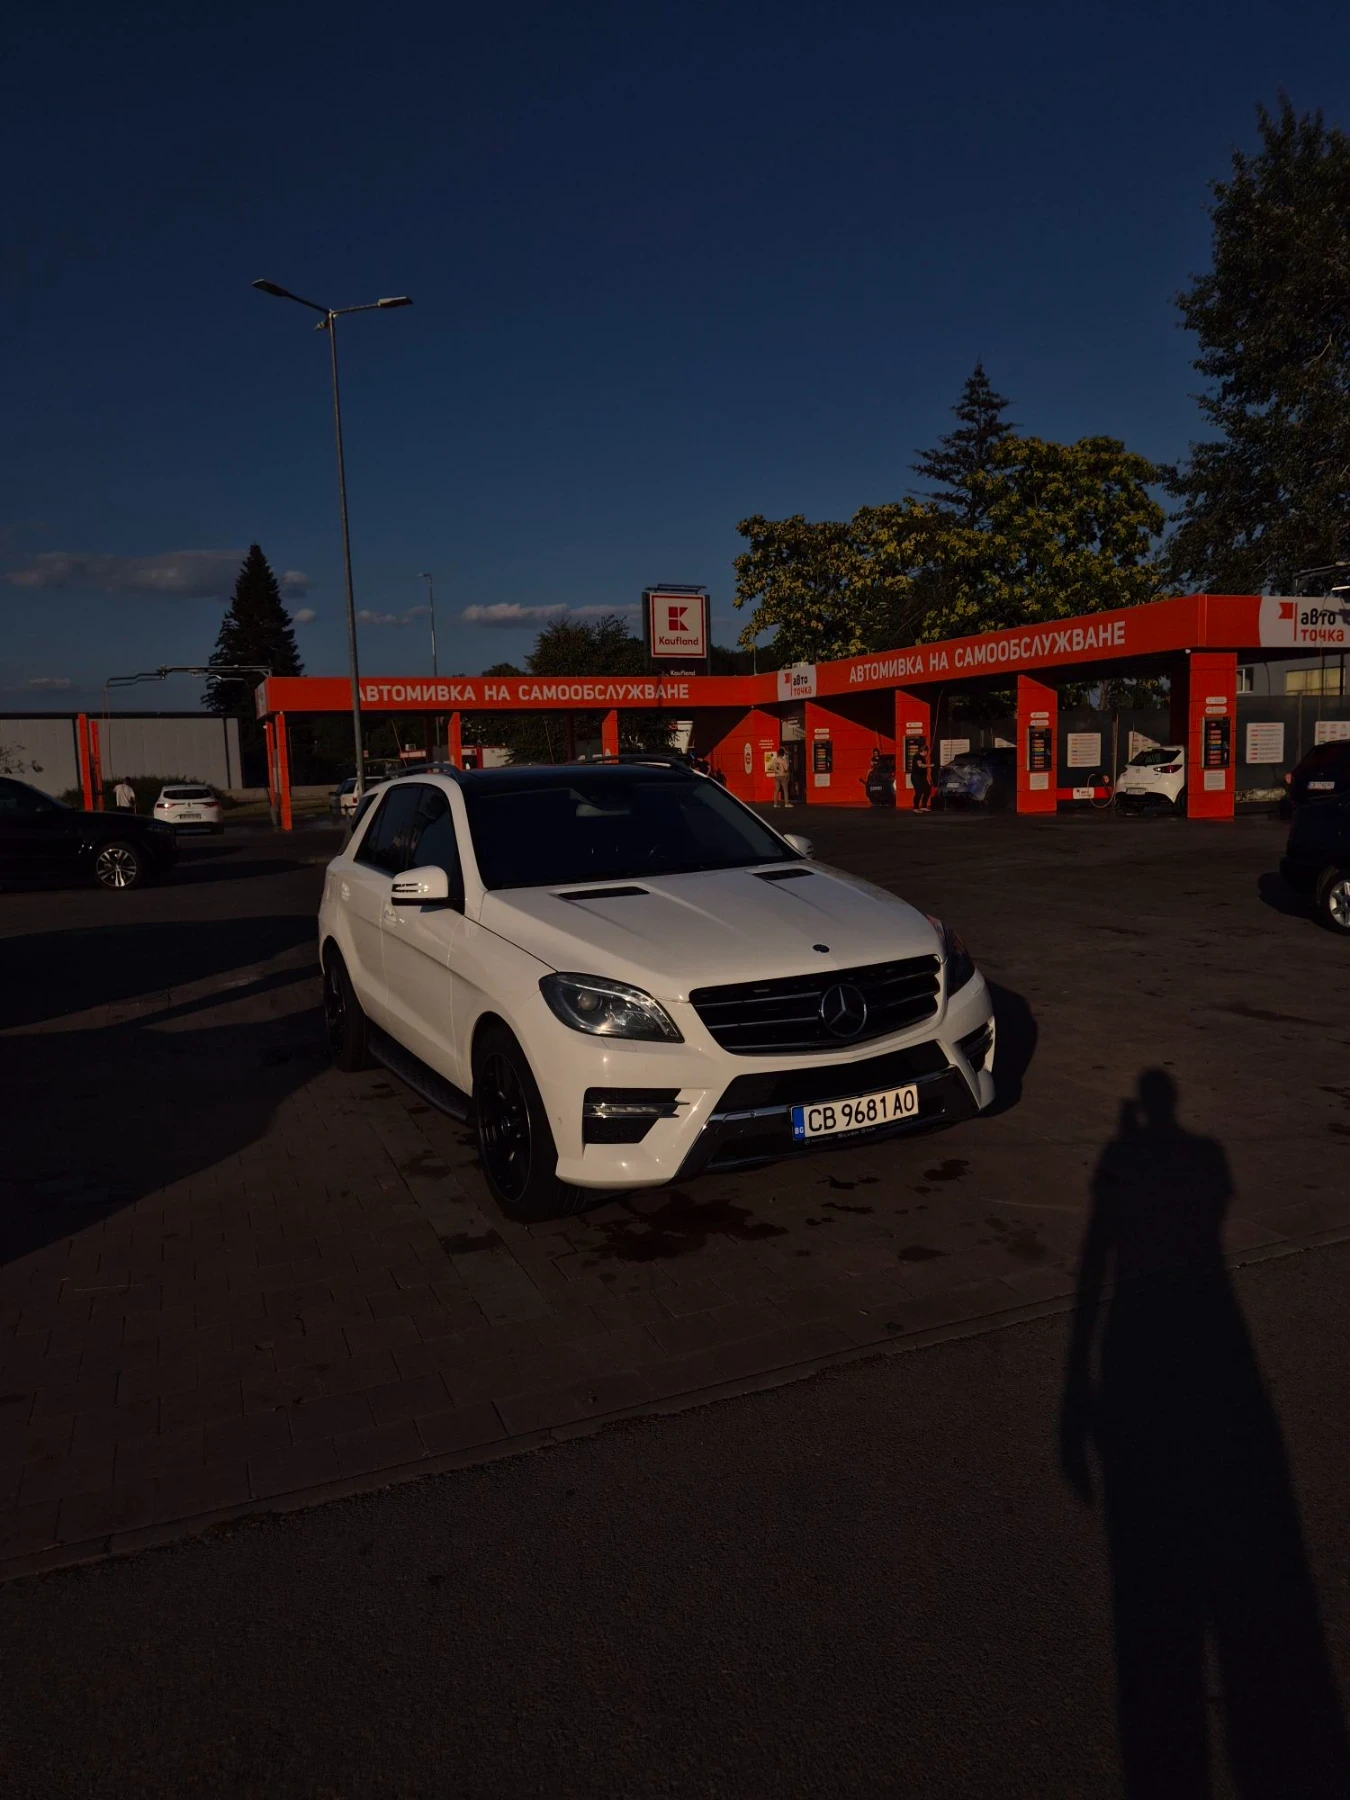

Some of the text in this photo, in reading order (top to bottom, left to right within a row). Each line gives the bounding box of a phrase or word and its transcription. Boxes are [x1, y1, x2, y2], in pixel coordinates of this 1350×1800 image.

[1301, 608, 1335, 625] авто
[659, 636, 699, 646] Kaufland
[1301, 629, 1345, 642] точка
[849, 620, 1126, 683] АВТОМИВКА НА САМООБСЛУЖВАНЕ
[484, 685, 511, 701] НА
[518, 684, 689, 700] САМООБСЛУЖВАНЕ
[841, 1096, 888, 1127] 9681
[794, 1126, 805, 1135] BG
